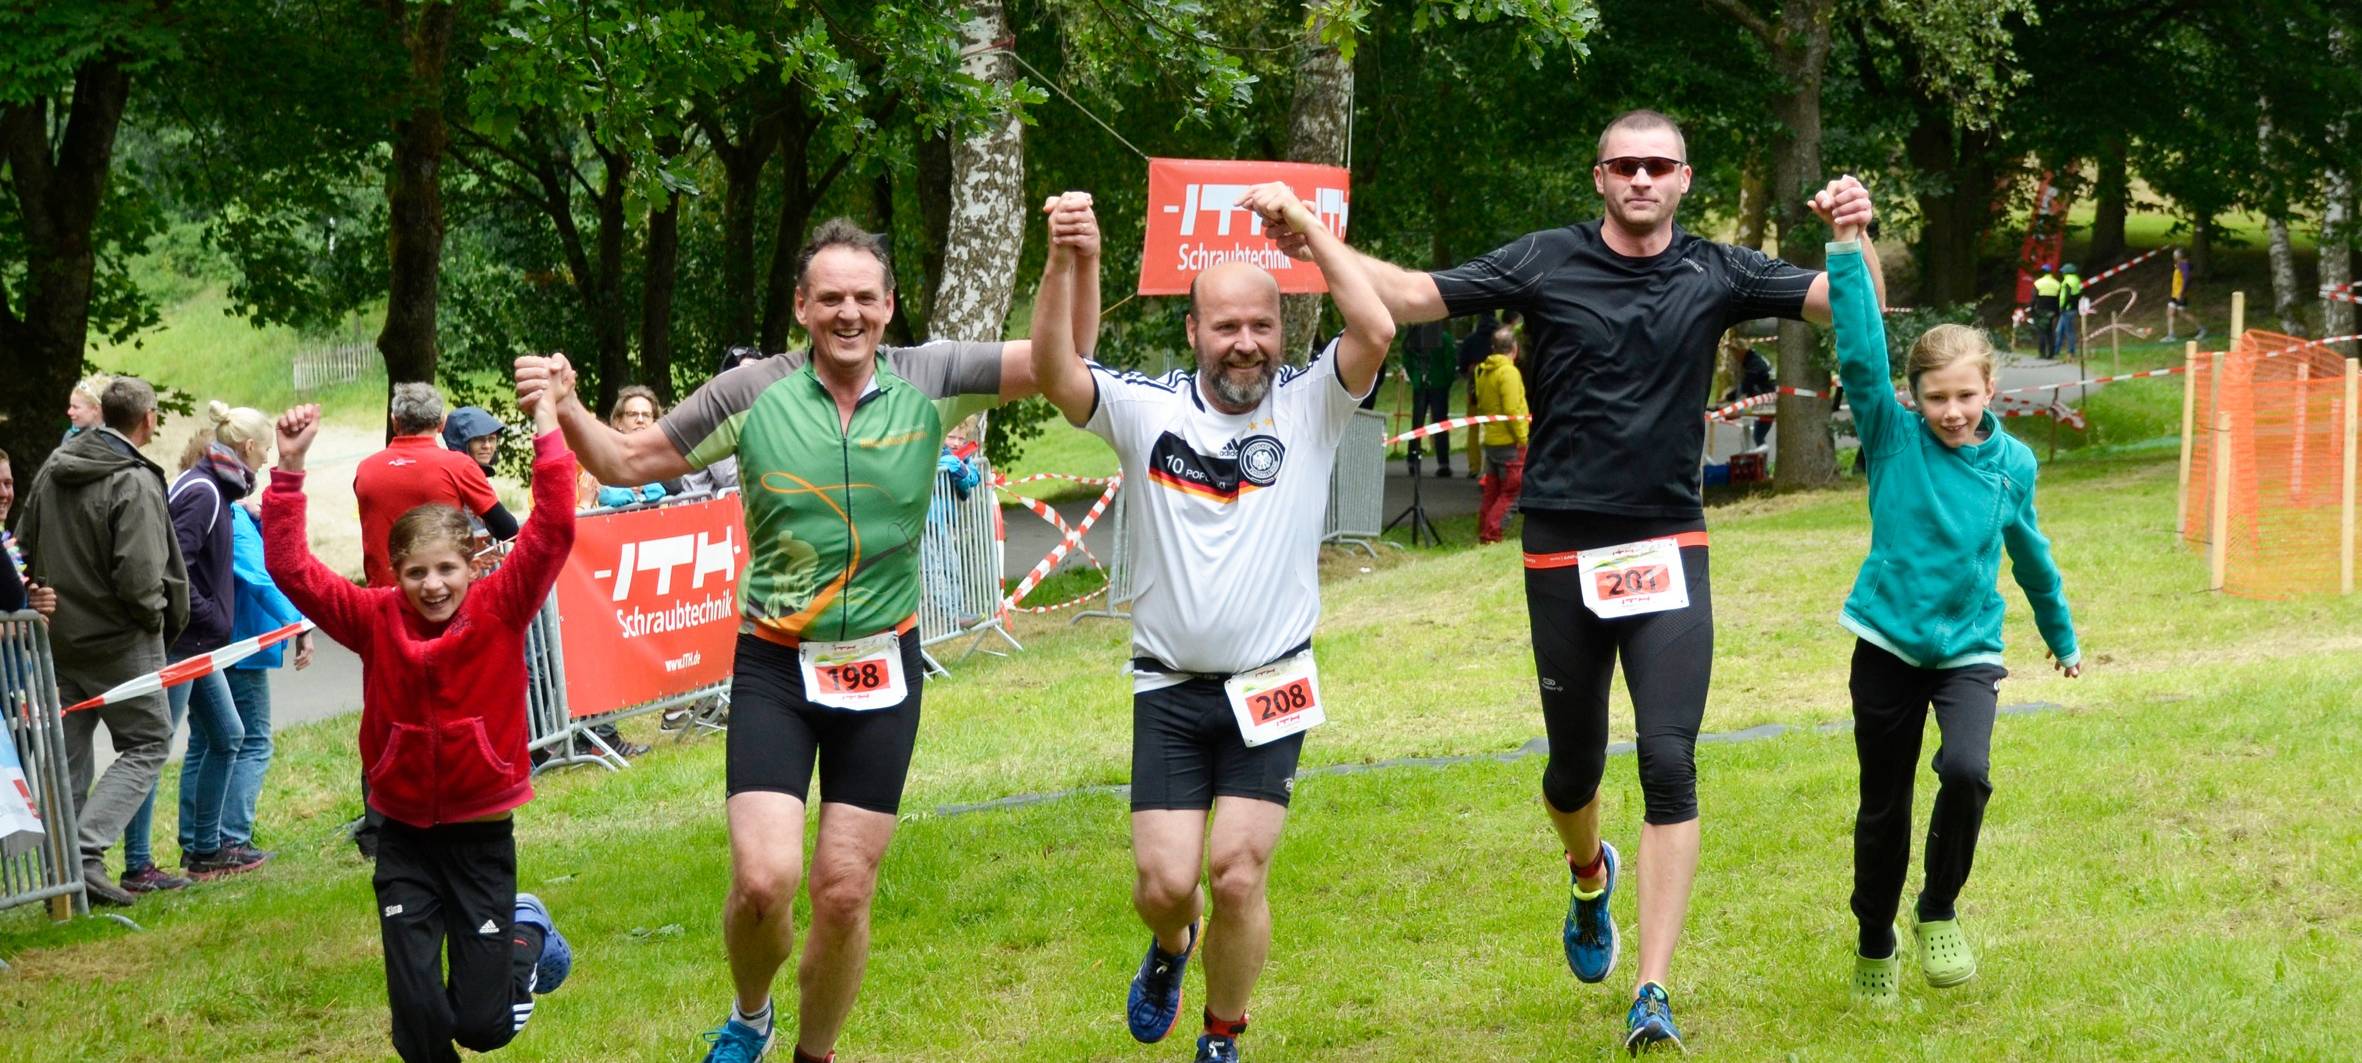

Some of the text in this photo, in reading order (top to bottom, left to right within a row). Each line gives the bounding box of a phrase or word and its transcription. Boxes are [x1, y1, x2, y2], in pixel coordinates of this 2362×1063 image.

[1165, 454, 1185, 474] 10
[616, 588, 733, 639] Schraubtechnik
[665, 649, 701, 673] www.ITH.de
[827, 663, 880, 691] 198
[1255, 684, 1307, 721] 208
